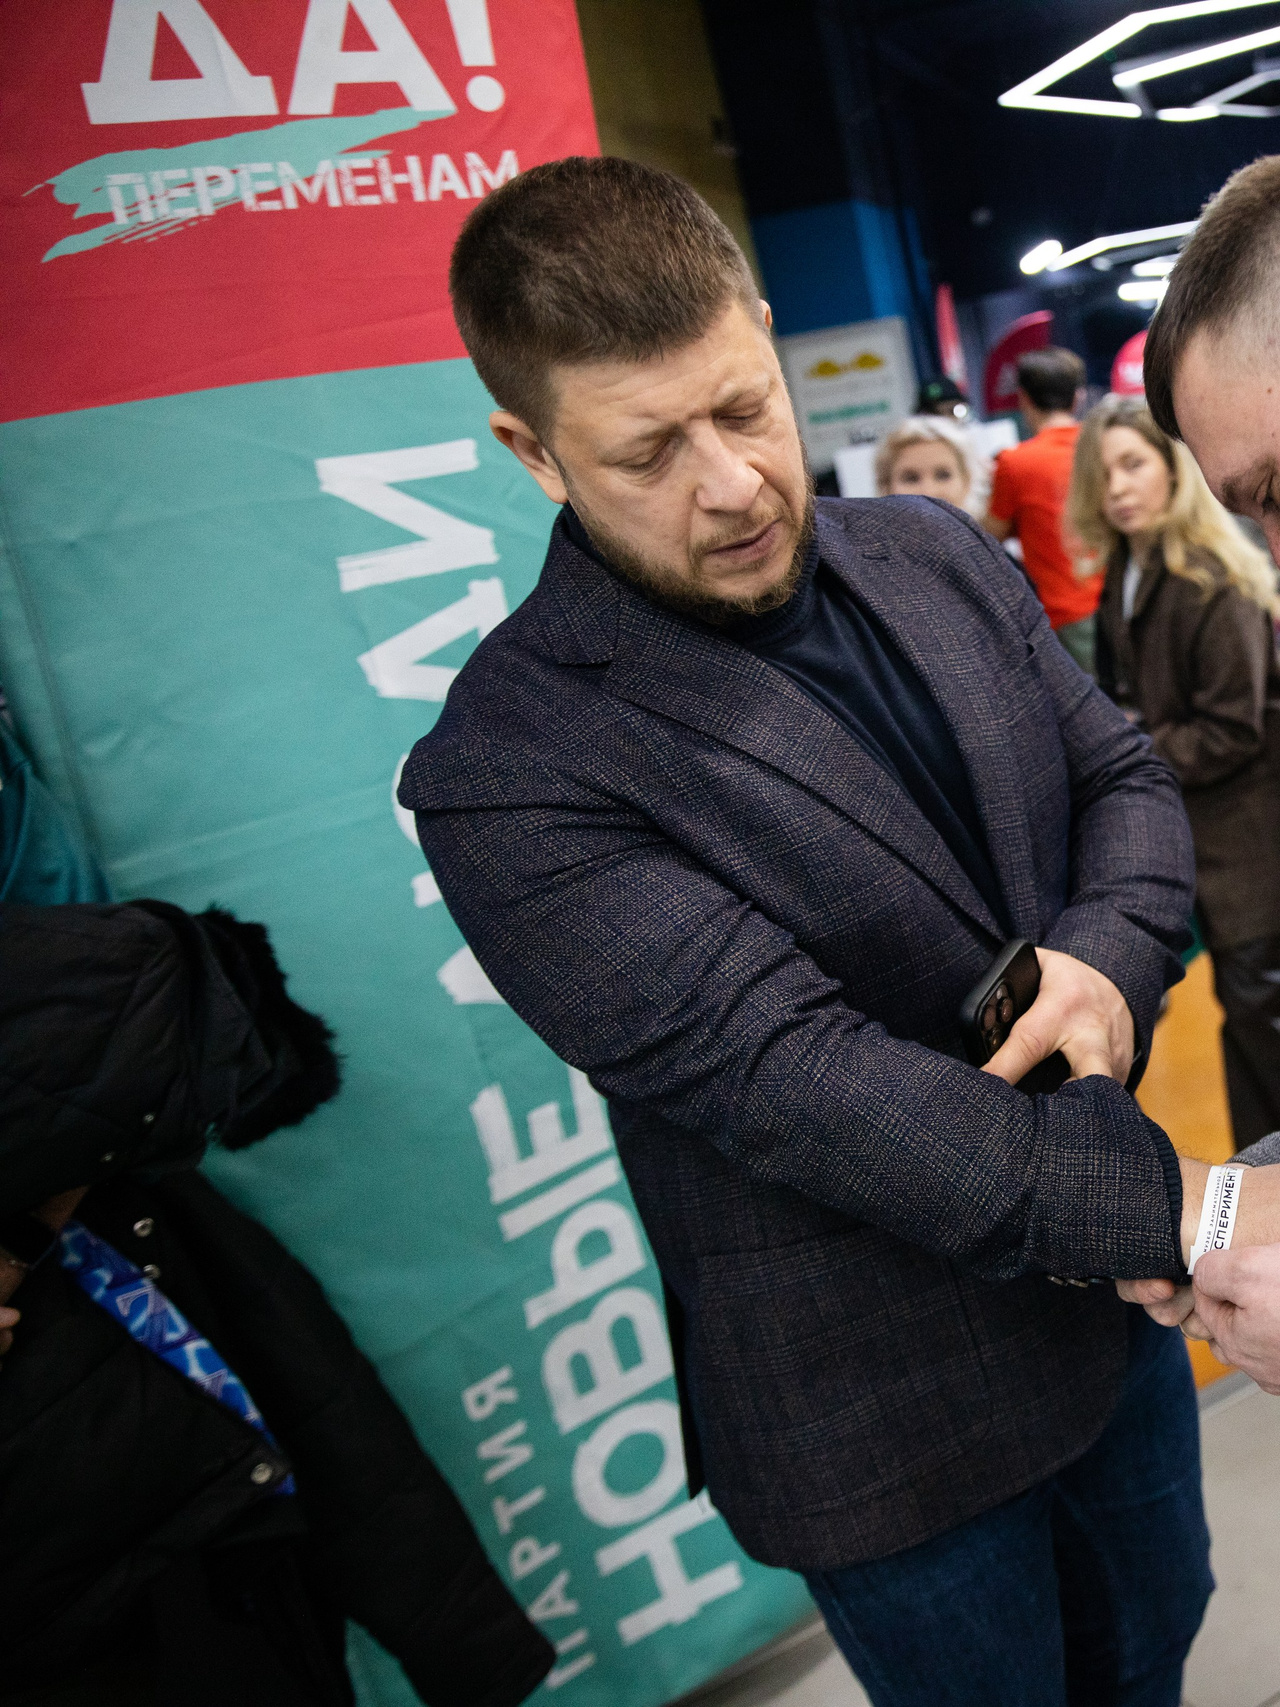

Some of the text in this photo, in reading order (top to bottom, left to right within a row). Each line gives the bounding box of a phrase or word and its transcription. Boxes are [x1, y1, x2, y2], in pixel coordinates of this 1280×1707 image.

[81, 0, 505, 125] ДА!
[105, 150, 519, 226] ПЕРЕМЕНАМ
[468, 1063, 744, 1647] НОВЫЕ
[462, 1364, 597, 1688] ПАРТИЯ
